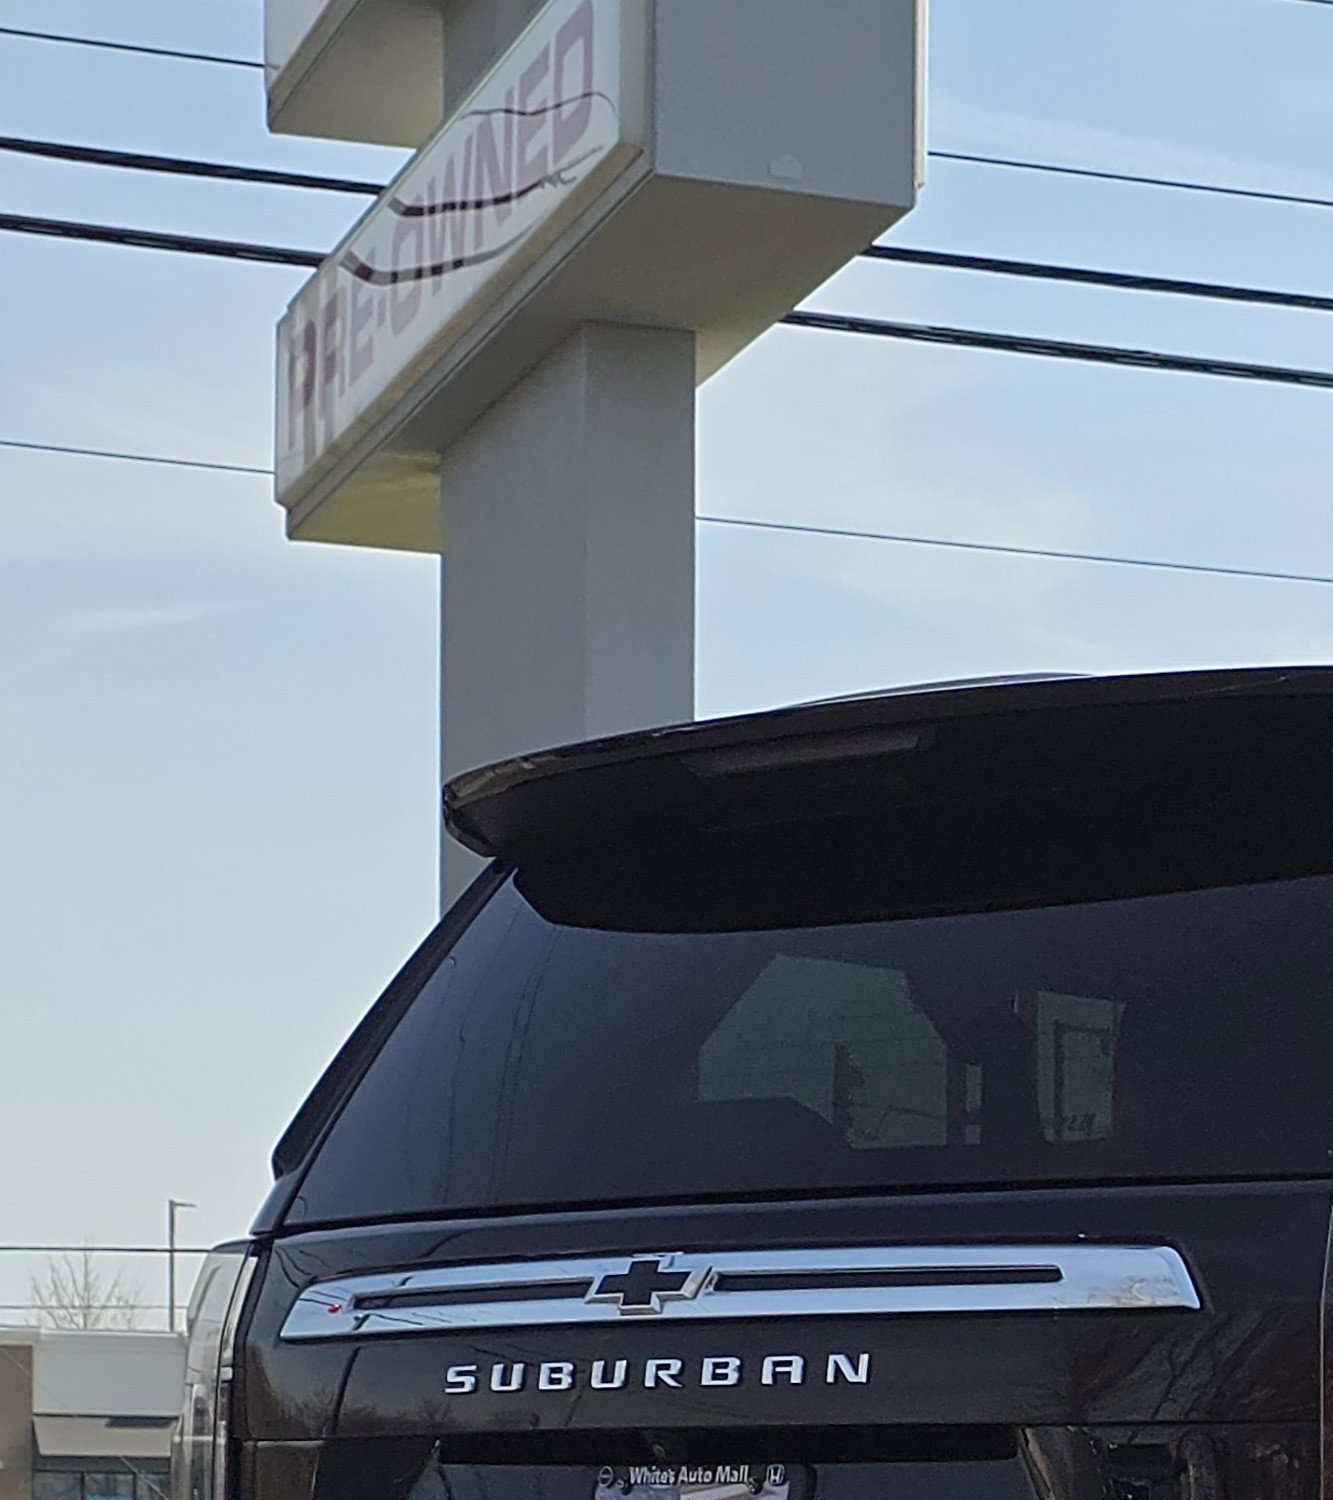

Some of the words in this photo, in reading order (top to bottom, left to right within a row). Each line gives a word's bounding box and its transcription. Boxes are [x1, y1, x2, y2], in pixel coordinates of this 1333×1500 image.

[444, 1353, 869, 1393] SUBURBAN
[629, 1466, 676, 1484] White's
[678, 1466, 712, 1484] Auto
[715, 1465, 748, 1483] Mall
